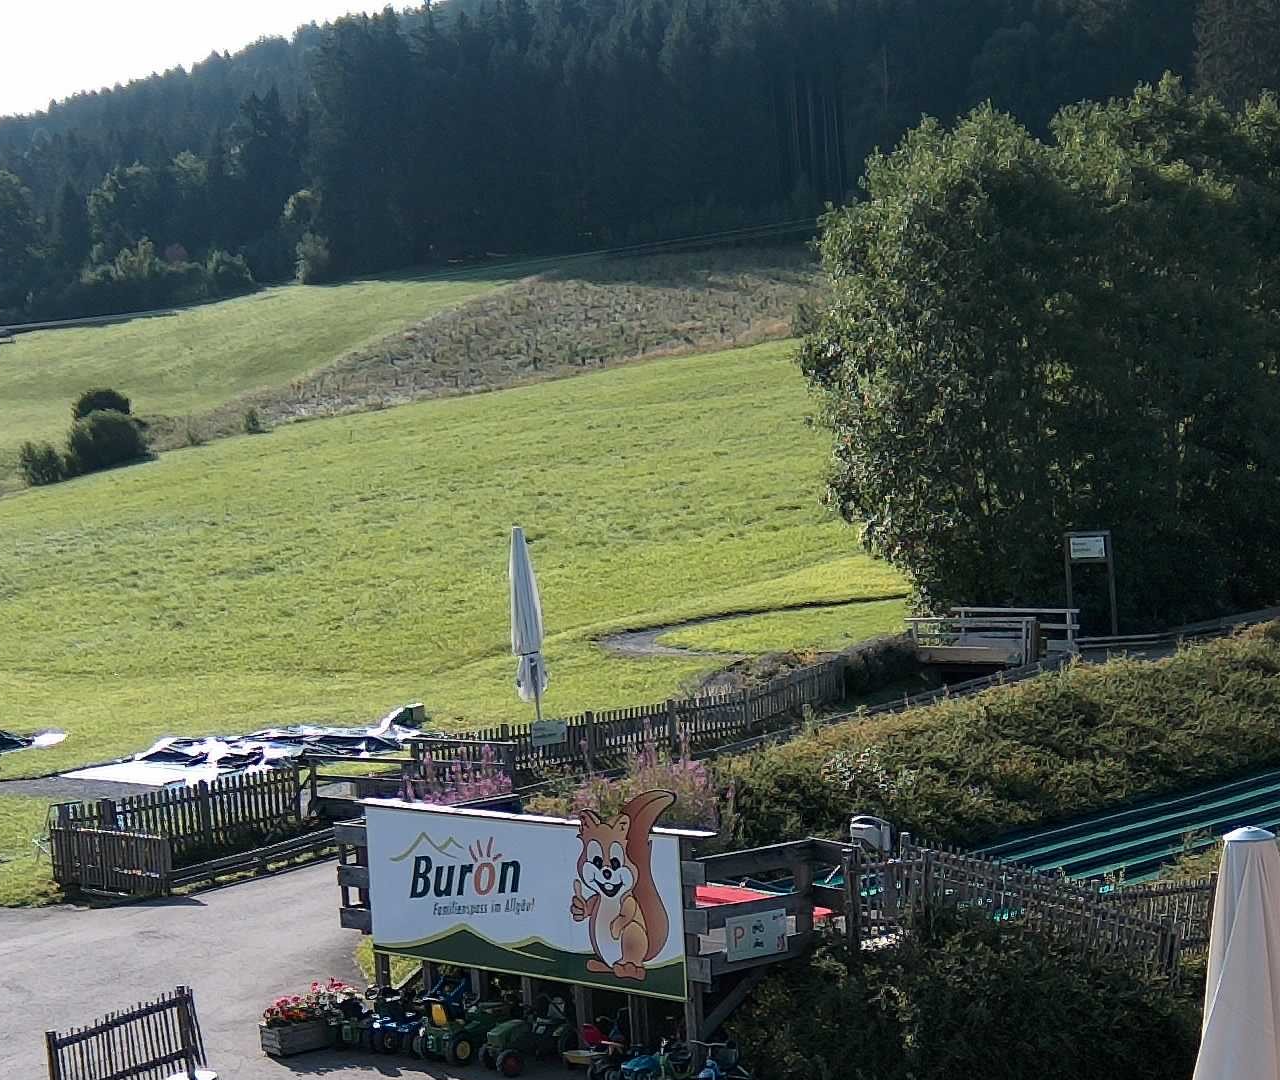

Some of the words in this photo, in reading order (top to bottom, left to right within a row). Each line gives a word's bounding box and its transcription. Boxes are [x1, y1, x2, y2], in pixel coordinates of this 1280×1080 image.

[409, 855, 521, 899] Buron
[433, 902, 488, 916] Familienspass
[491, 903, 501, 913] im
[734, 926, 746, 949] P
